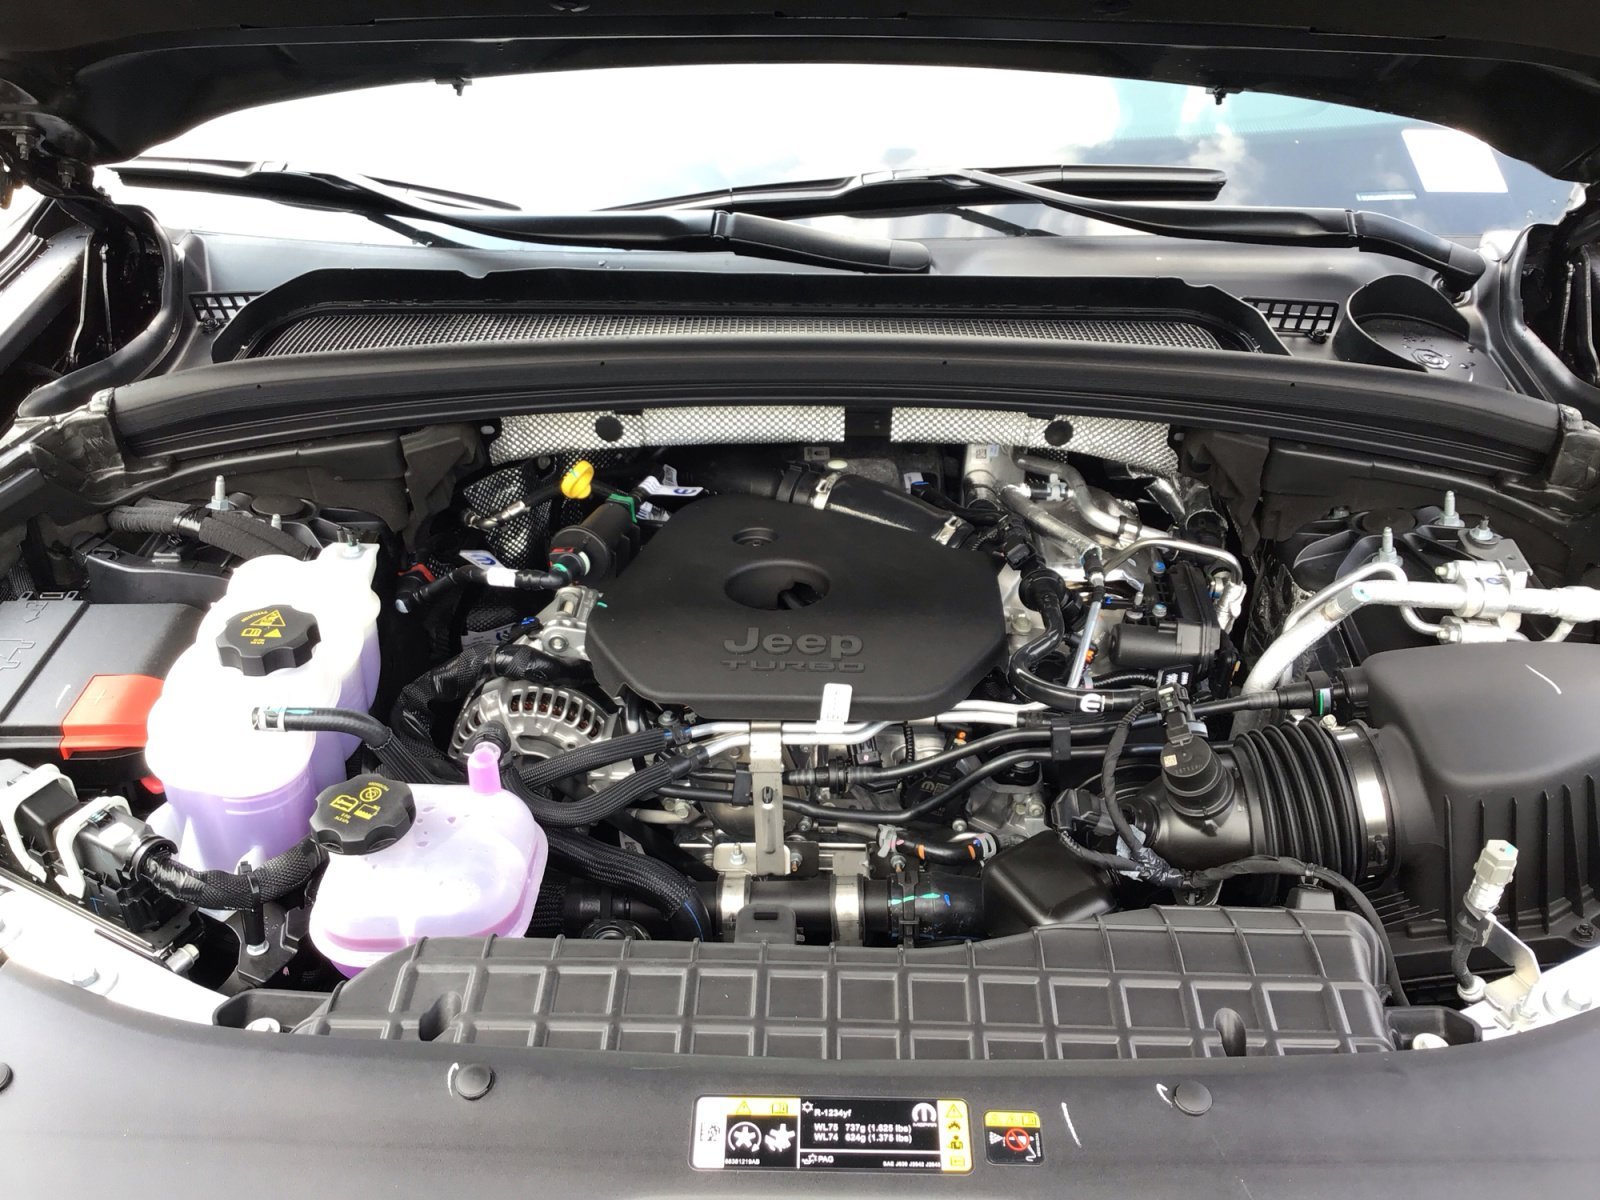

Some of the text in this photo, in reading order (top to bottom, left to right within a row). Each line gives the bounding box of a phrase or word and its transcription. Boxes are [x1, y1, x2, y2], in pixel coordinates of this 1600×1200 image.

[723, 627, 863, 661] Jeep
[720, 659, 866, 673] TURBO
[814, 1108, 852, 1119] R-1234yf
[814, 1123, 839, 1132] WL75
[845, 1123, 866, 1133] 737g
[814, 1132, 839, 1141] WL74
[845, 1133, 866, 1143] 624g
[818, 1155, 834, 1164] PAG
